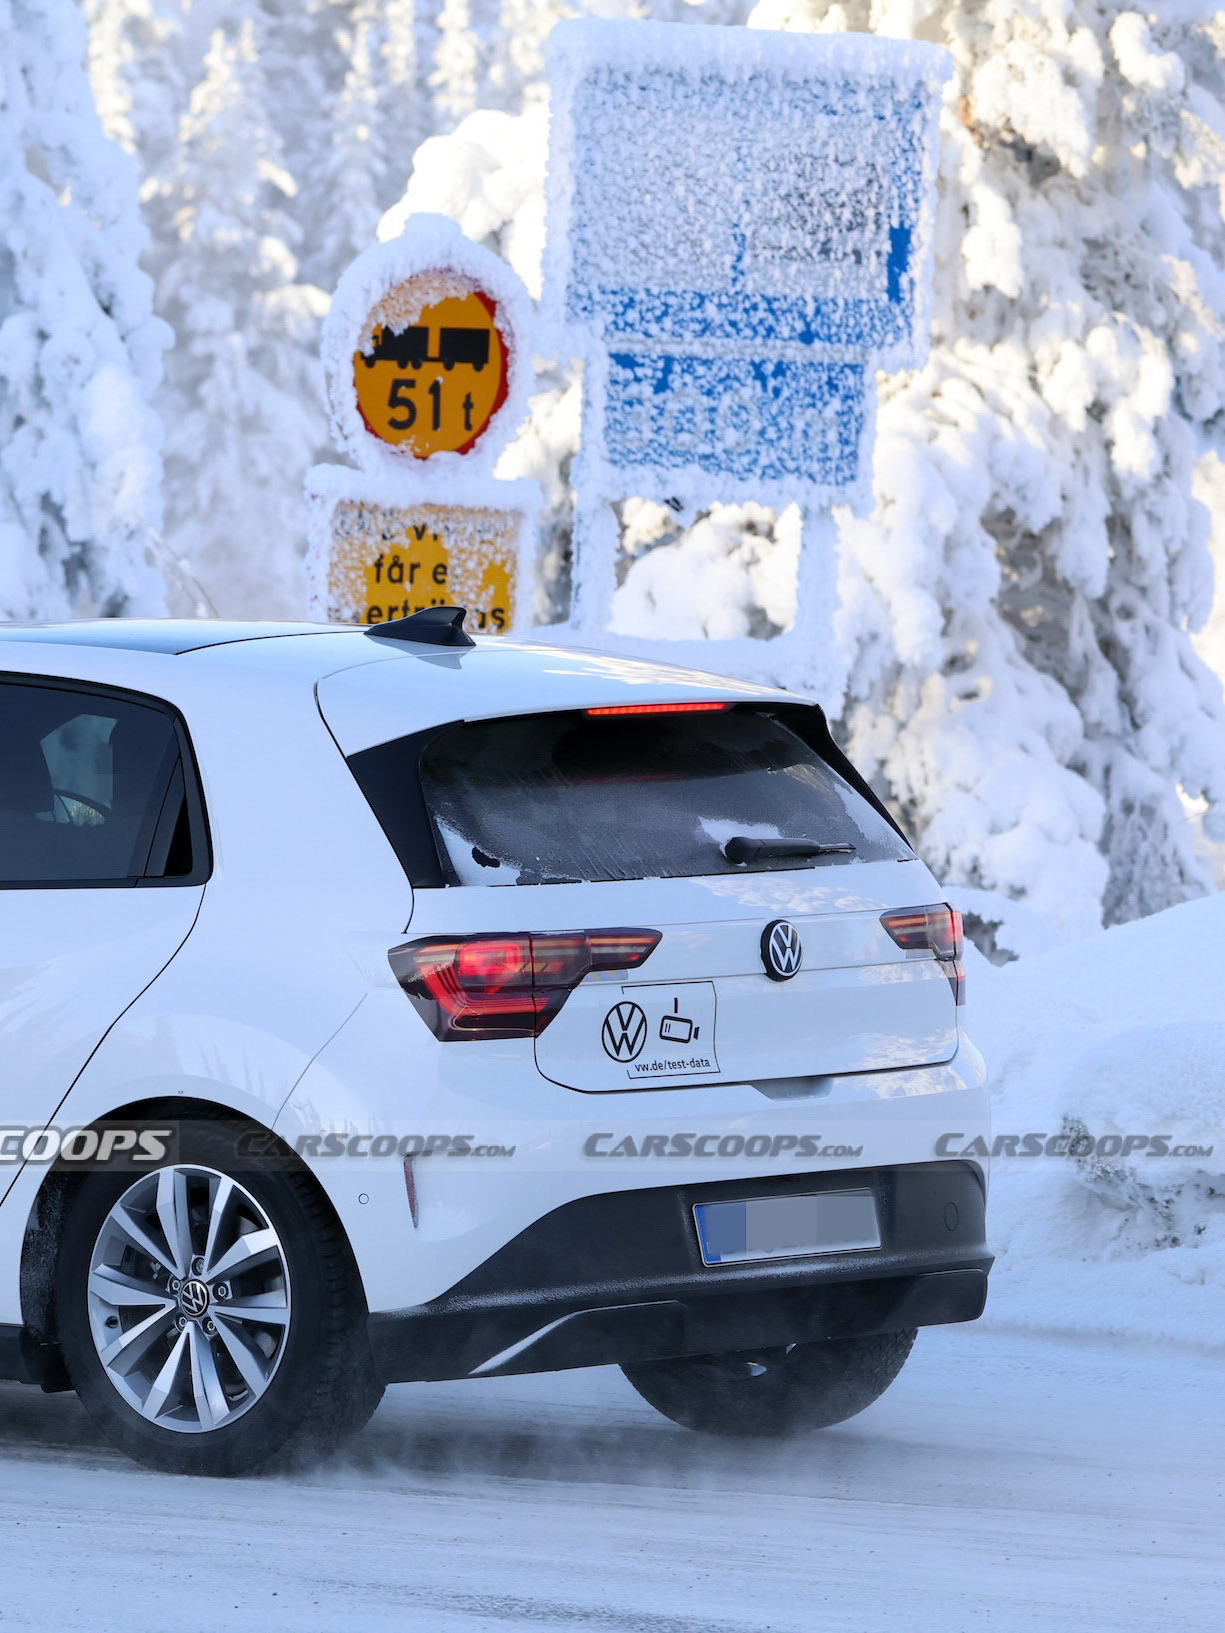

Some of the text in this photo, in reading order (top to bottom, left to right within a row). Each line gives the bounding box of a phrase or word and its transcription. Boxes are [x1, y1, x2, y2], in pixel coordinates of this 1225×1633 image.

[387, 379, 474, 431] 51 t
[374, 554, 421, 585] får
[602, 1001, 647, 1063] VW
[635, 1057, 711, 1072] vw.de/test-data
